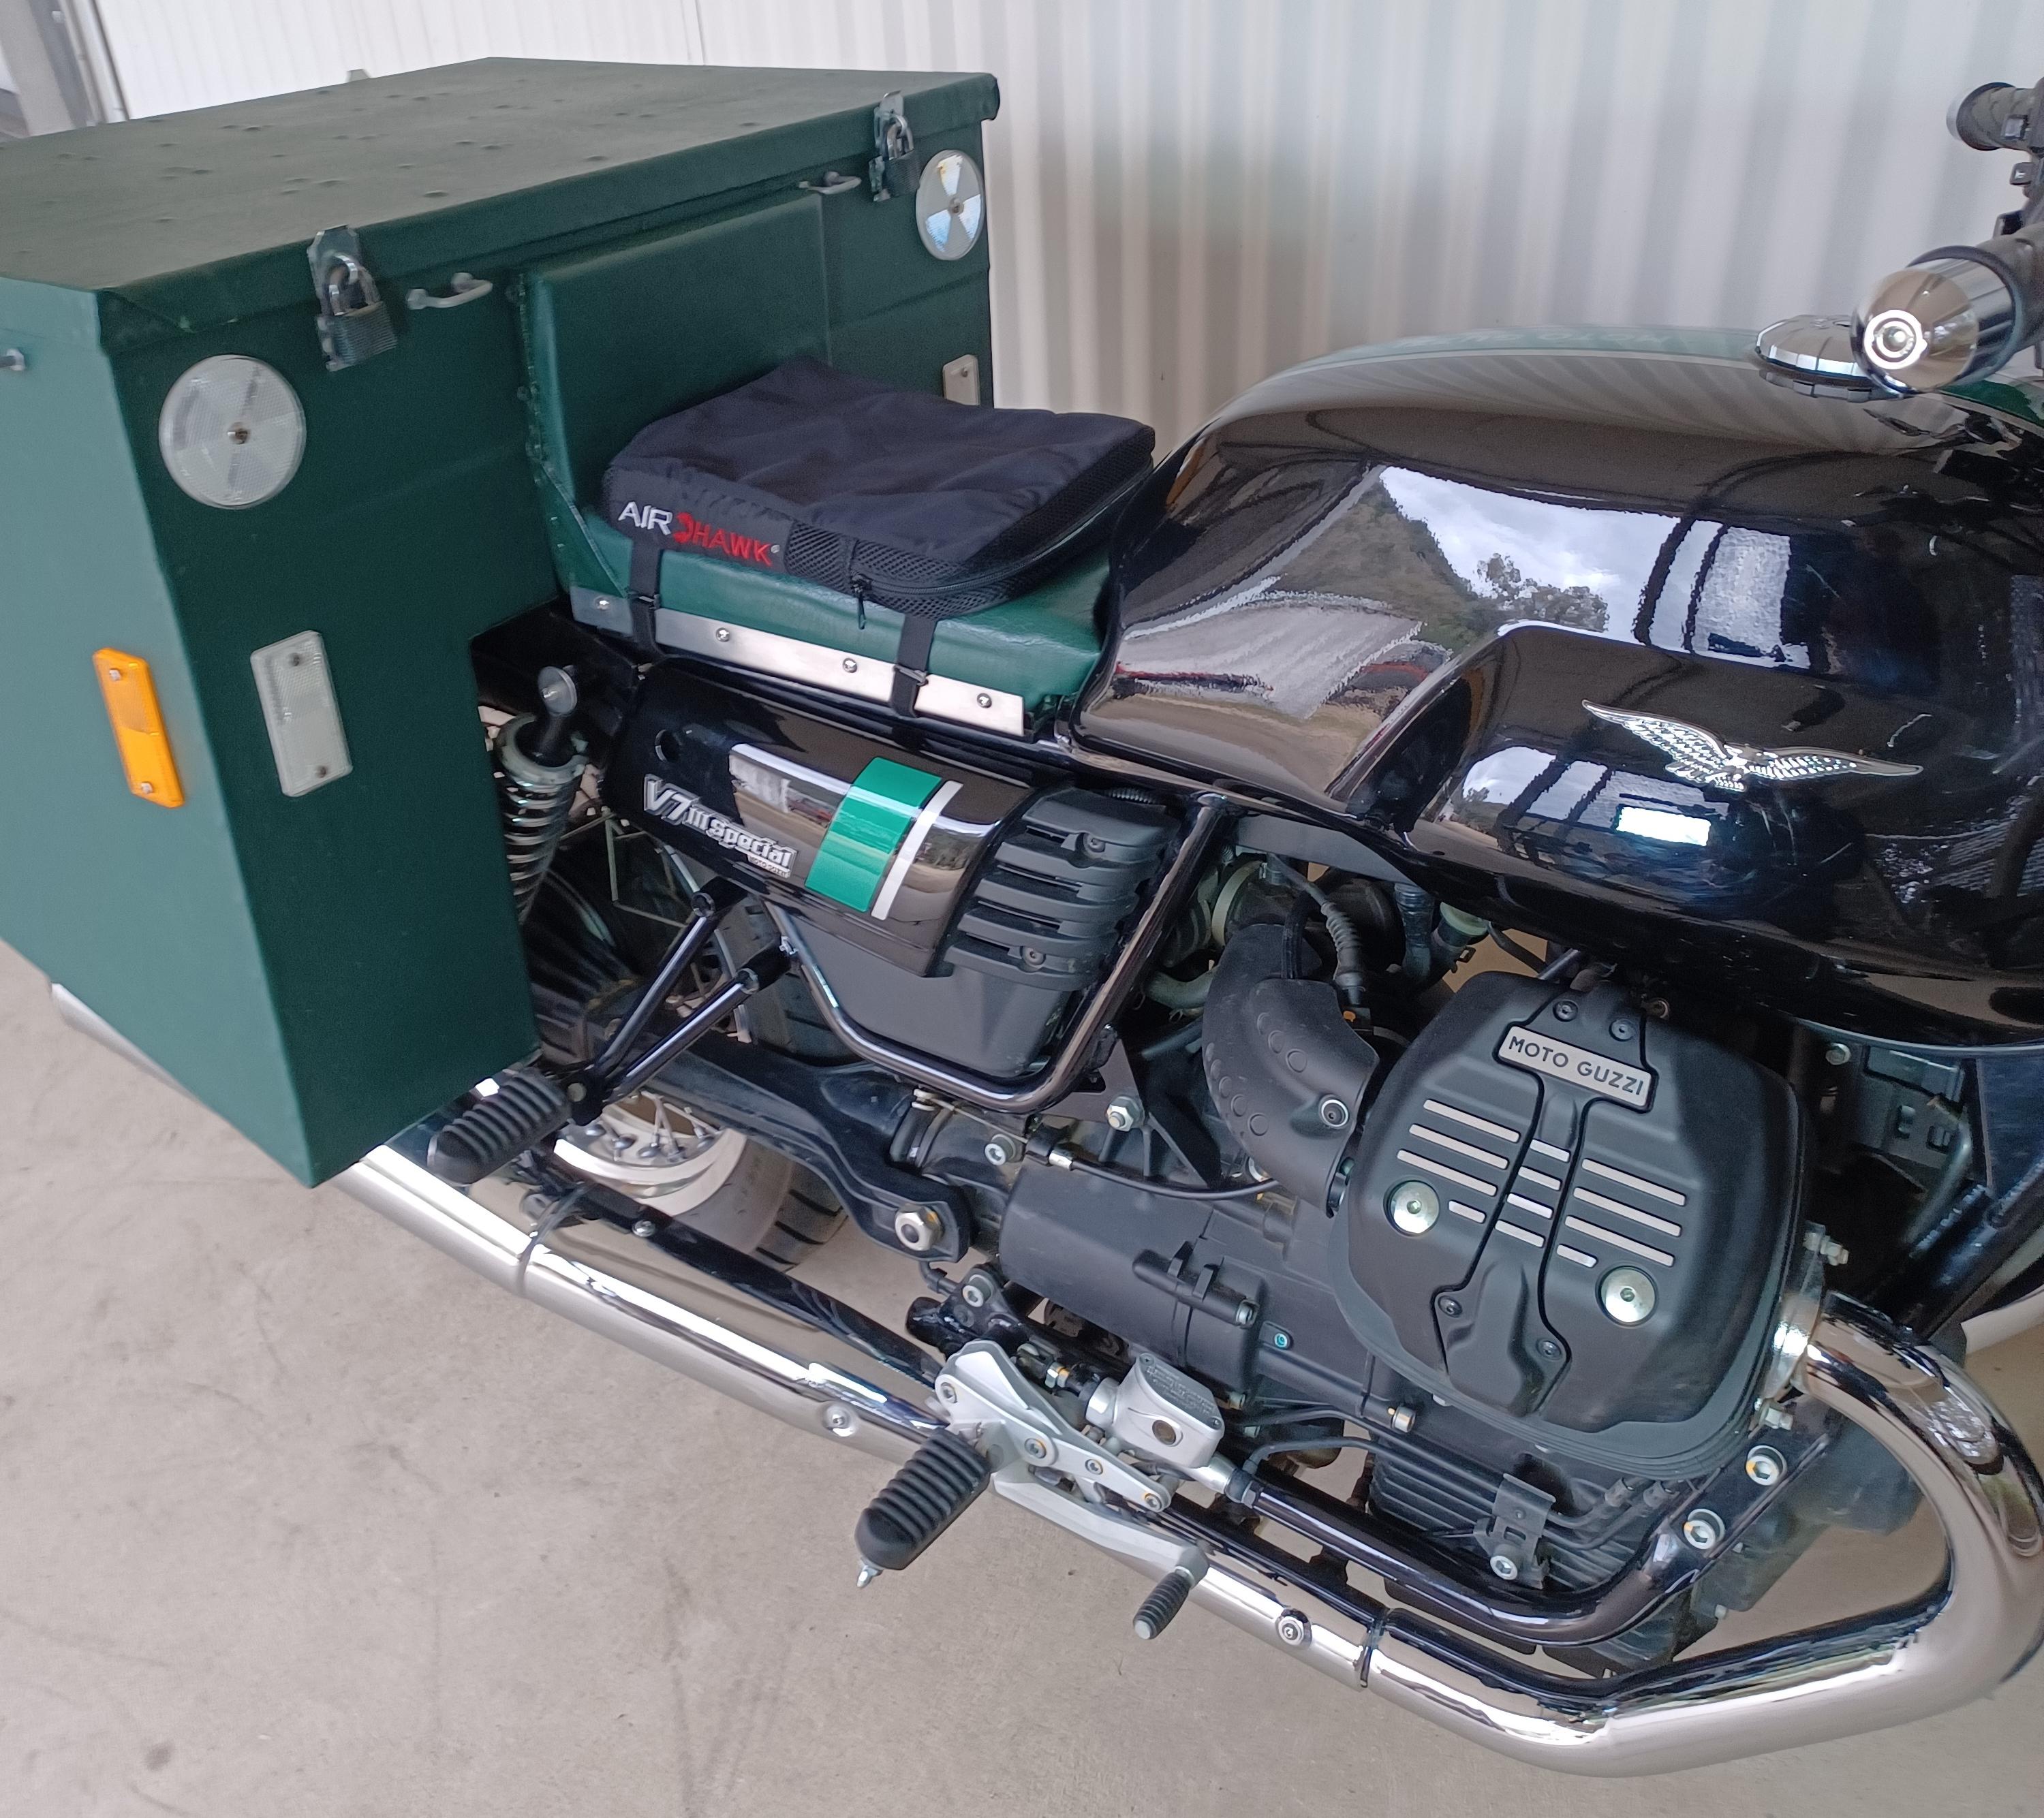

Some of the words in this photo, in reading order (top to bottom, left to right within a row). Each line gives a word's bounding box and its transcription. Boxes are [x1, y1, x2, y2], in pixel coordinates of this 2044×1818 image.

[618, 501, 673, 535] AIR
[1508, 1035, 1569, 1067] MOTO
[1577, 1061, 1644, 1095] GUZZI
